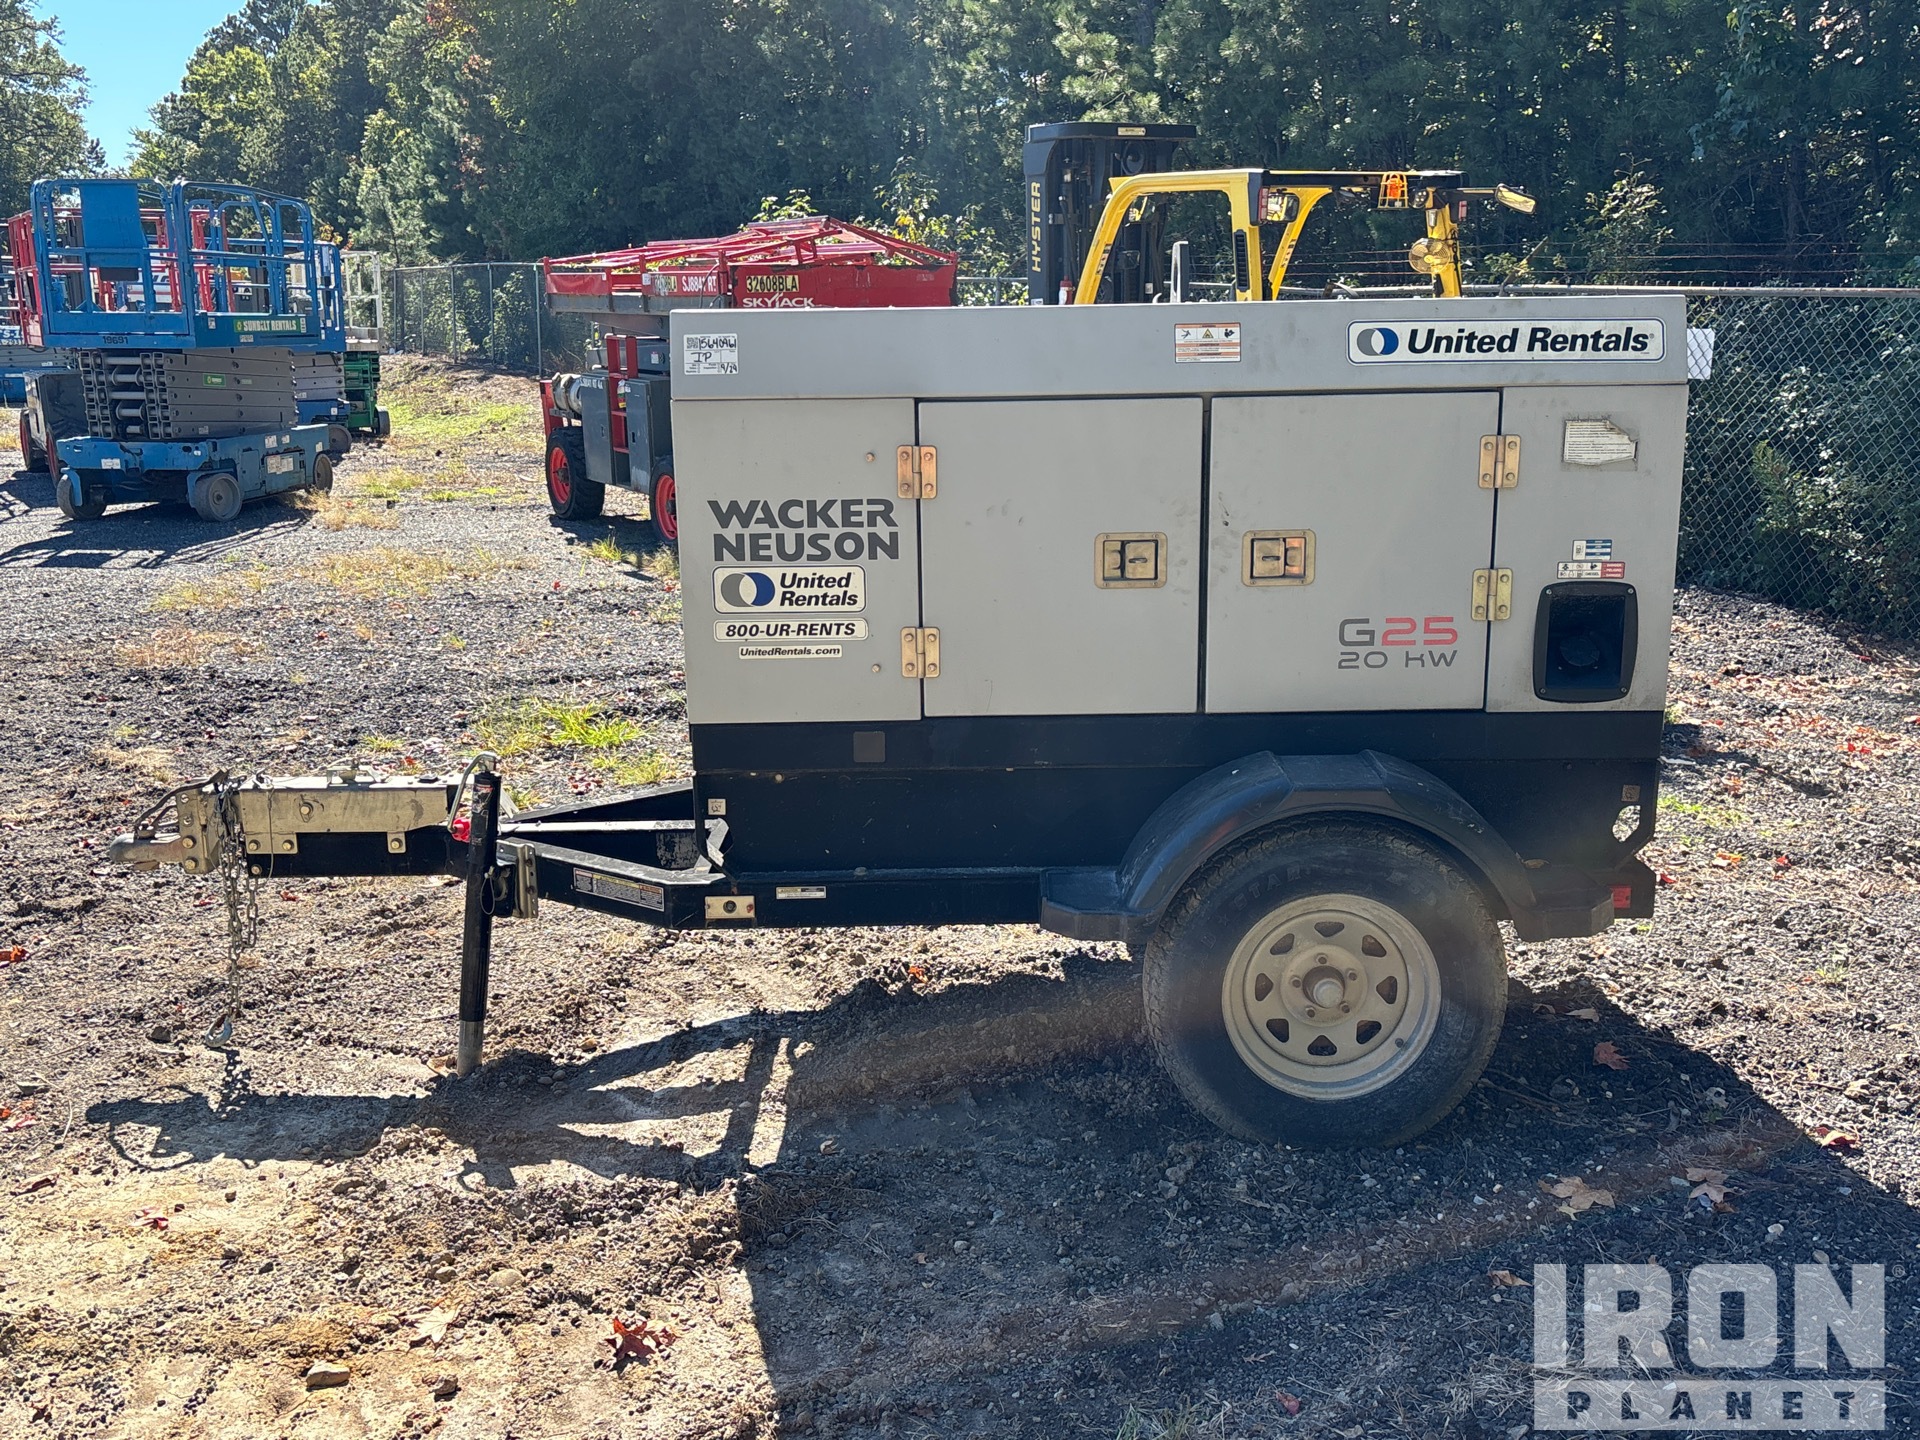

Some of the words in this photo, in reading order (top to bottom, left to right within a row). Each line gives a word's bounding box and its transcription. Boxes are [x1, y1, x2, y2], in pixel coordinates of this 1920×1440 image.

[1031, 181, 1041, 272] HYSTER
[746, 275, 799, 293] 32608BLA
[743, 293, 814, 308] SKYJACK
[271, 319, 297, 331] RENTALS
[102, 335, 129, 345] 19691
[1407, 327, 1519, 354] United
[1526, 326, 1649, 353] Rentals
[707, 499, 899, 529] WACKER
[713, 531, 900, 562] NEUSON
[780, 572, 852, 588] United
[779, 590, 858, 607] Rentals
[725, 622, 856, 637] 800-UR-RENTS
[1338, 616, 1459, 646] G25
[740, 647, 841, 657] UnitedRentals.com
[1338, 651, 1388, 669] 20
